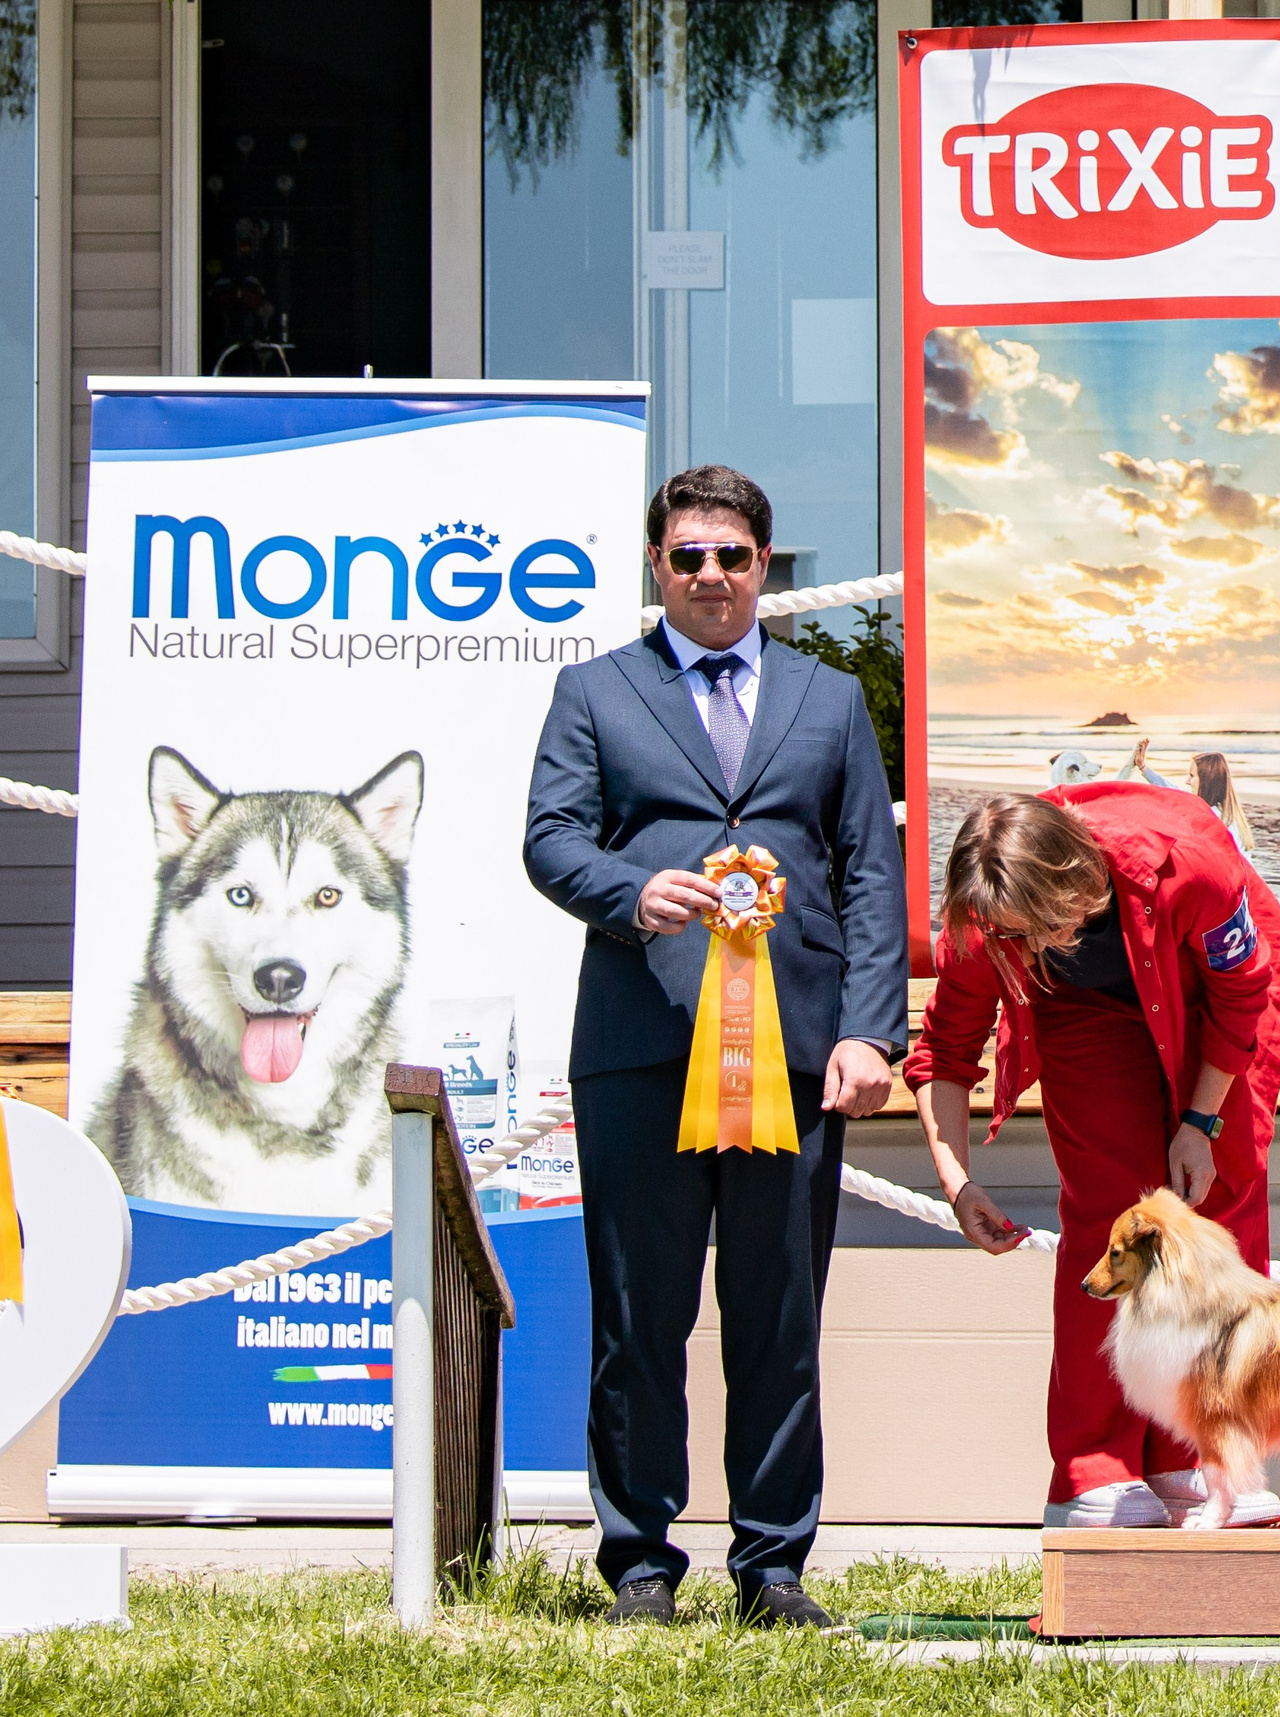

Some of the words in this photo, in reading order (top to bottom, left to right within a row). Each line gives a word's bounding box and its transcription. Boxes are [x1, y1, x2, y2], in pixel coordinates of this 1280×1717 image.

[129, 623, 274, 660] Natural
[291, 623, 596, 669] Superpremium
[723, 1047, 751, 1067] BIG
[234, 1275, 275, 1303] Dal
[278, 1272, 342, 1303] 1963
[344, 1272, 361, 1304] il
[363, 1279, 393, 1309] pe
[236, 1315, 329, 1348] italiano
[332, 1318, 369, 1349] nel
[268, 1403, 394, 1431] www.monge
